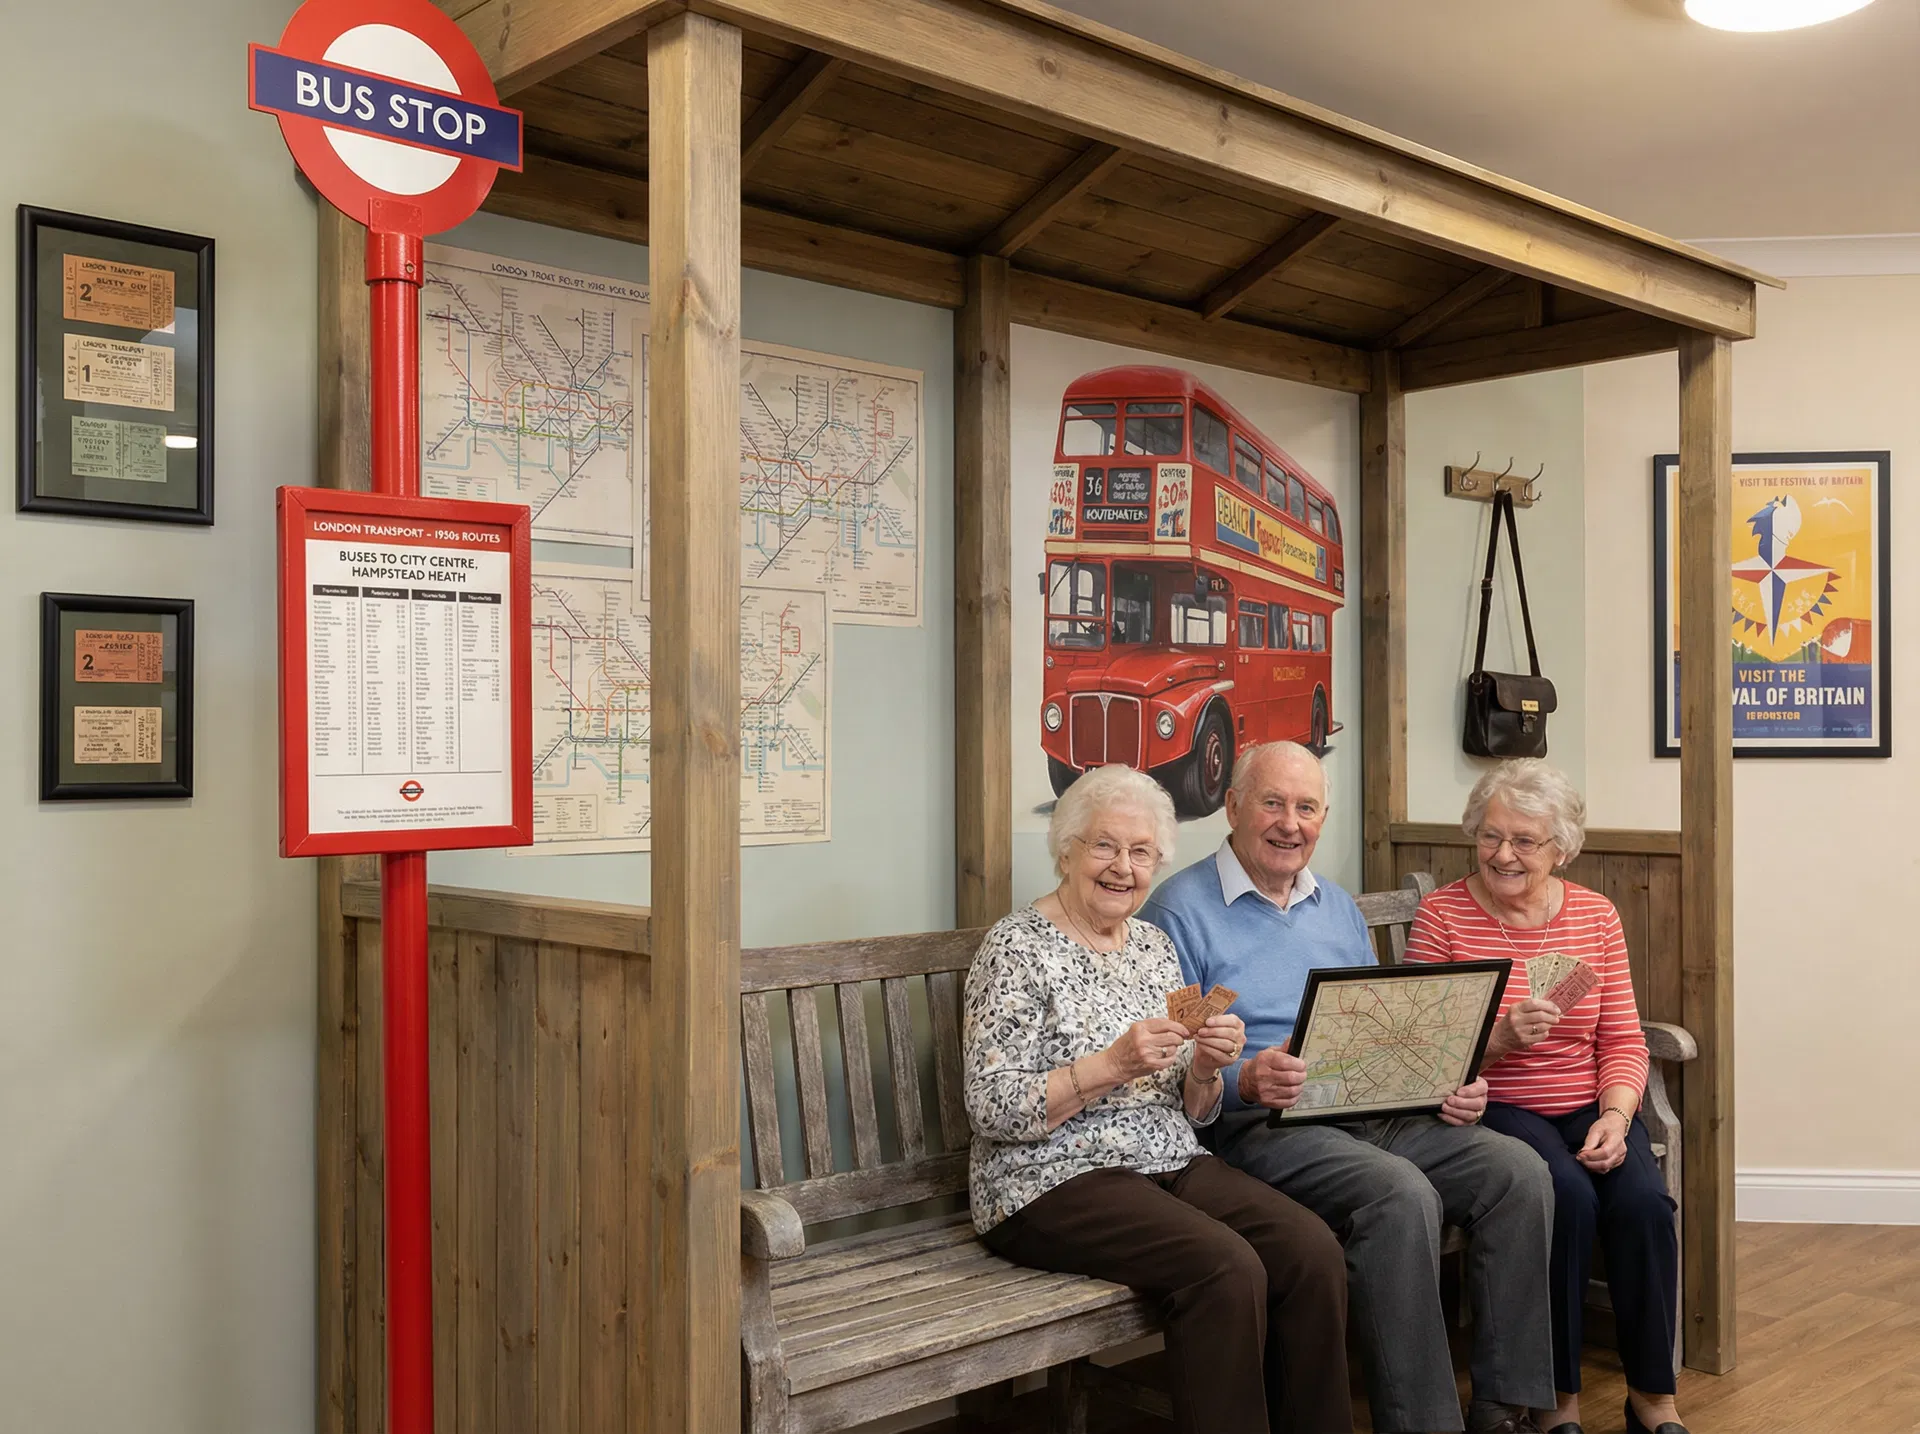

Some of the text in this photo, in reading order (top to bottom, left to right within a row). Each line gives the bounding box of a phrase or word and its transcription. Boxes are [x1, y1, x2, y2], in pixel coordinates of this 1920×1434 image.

[296, 69, 487, 145] BUS STOP
[491, 263, 527, 277] LONDON
[80, 283, 92, 302] 2
[82, 364, 91, 383] 1
[1085, 476, 1102, 496] 36
[1739, 478, 1761, 487] VISIT
[1780, 476, 1816, 487] FESTIVAL
[313, 521, 361, 534] LONDON
[363, 524, 424, 538] TRANSPORT
[434, 530, 459, 541] 1950s
[462, 532, 501, 544] ROUTES
[339, 550, 479, 570] BUSES TO CITY CENTRE,
[352, 566, 466, 583] HAMPSTEAD HEATH
[82, 654, 94, 671] 2
[1739, 669, 1806, 683] VISIT THE
[1766, 687, 1788, 706] OF
[1794, 687, 1865, 706] BRITAIN
